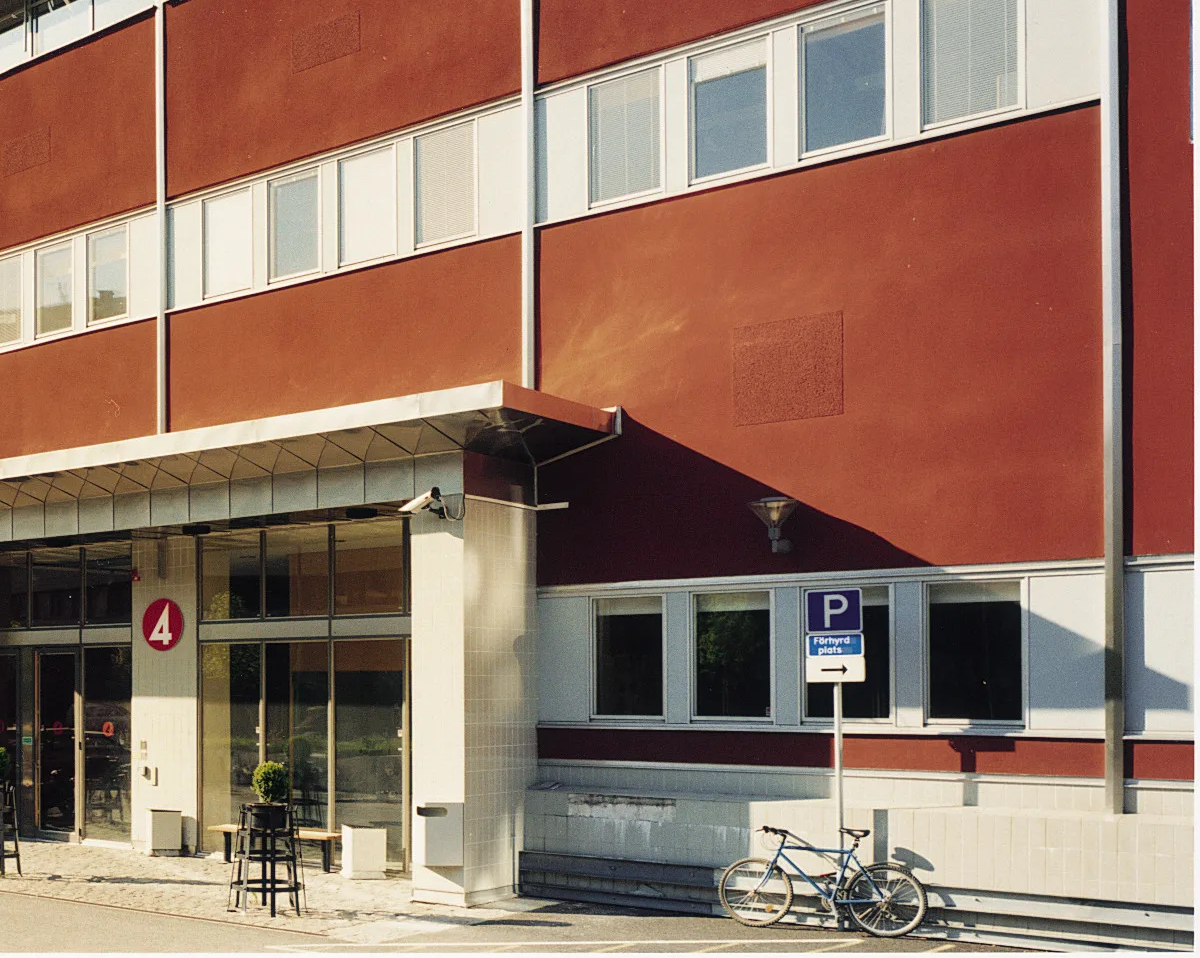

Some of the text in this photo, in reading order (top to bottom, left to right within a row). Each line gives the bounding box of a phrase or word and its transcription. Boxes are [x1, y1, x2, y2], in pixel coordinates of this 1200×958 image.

[823, 593, 849, 629] P
[148, 602, 172, 645] 4
[813, 635, 851, 646] Förhyrd
[817, 645, 843, 656] plats
